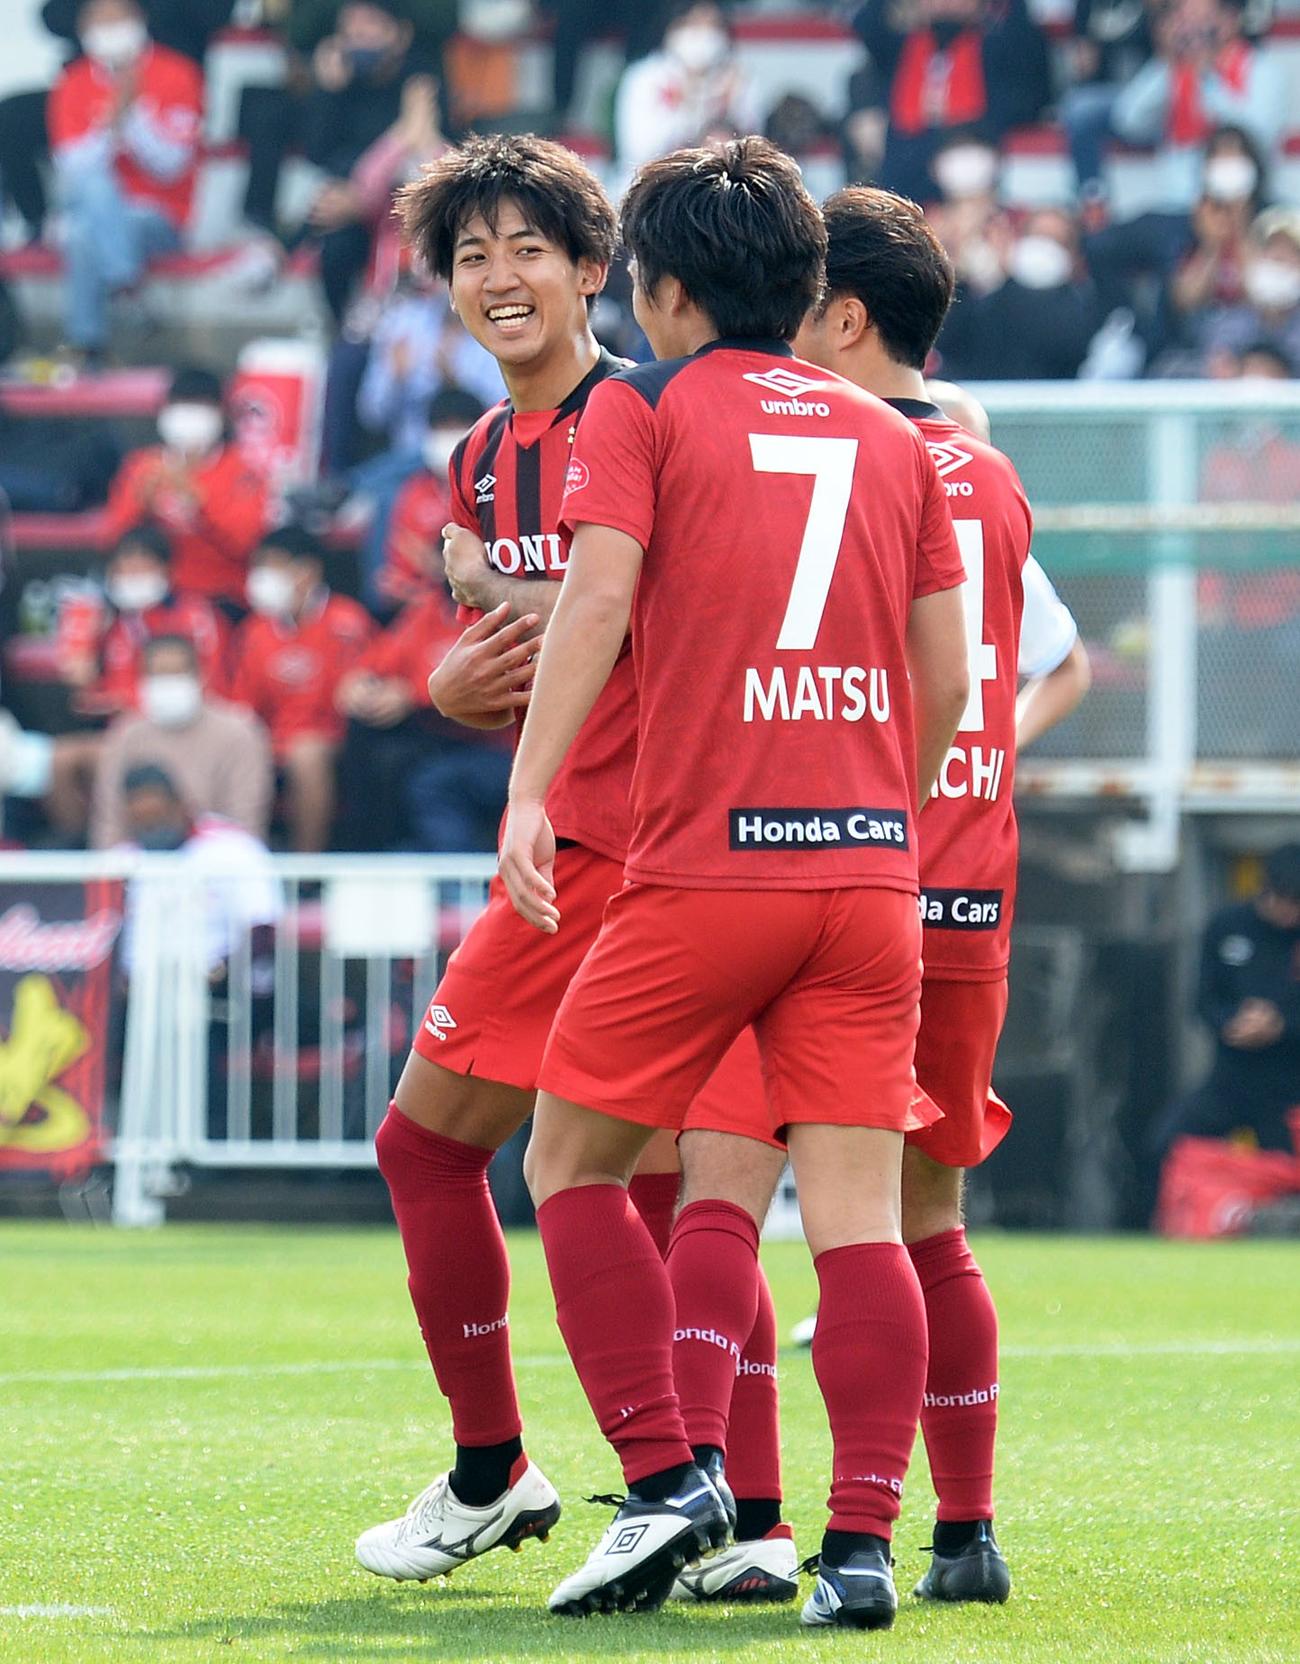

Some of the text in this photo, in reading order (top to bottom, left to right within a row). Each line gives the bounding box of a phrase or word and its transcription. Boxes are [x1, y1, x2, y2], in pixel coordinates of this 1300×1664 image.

[760, 398, 830, 418] umbro
[748, 433, 860, 650] 7
[743, 666, 890, 723] MATSU
[931, 745, 1006, 802] CHI
[738, 814, 905, 842] Honda Cars
[951, 896, 999, 922] Cars
[923, 1389, 988, 1407] Honda
